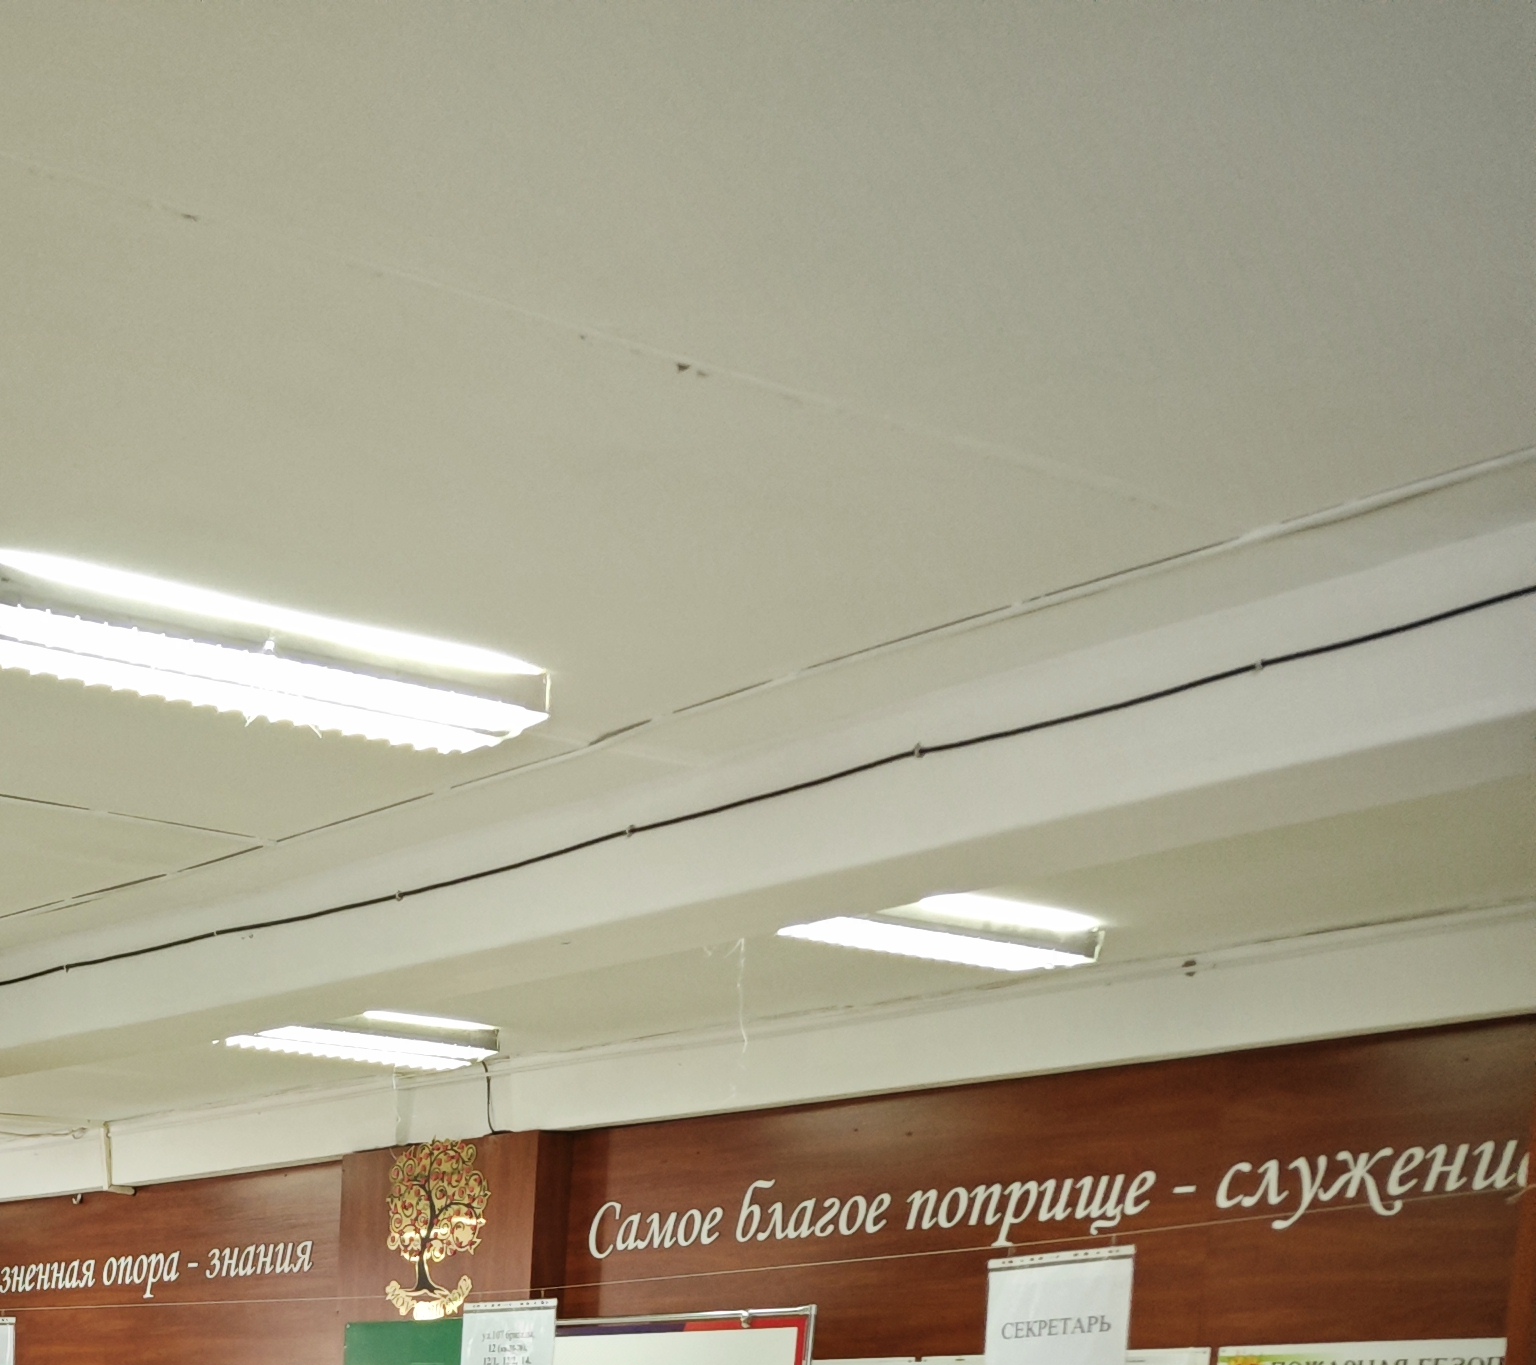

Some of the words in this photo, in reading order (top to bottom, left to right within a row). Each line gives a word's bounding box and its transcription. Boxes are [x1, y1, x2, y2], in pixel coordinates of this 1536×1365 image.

[588, 1201, 724, 1259] Самое
[735, 1179, 892, 1243] благое
[905, 1169, 1156, 1246] поприще
[1172, 1184, 1196, 1196] -
[103, 1250, 180, 1299] опора
[205, 1240, 313, 1279] знания
[1001, 1315, 1112, 1340] СЕКРЕТАРЬ
